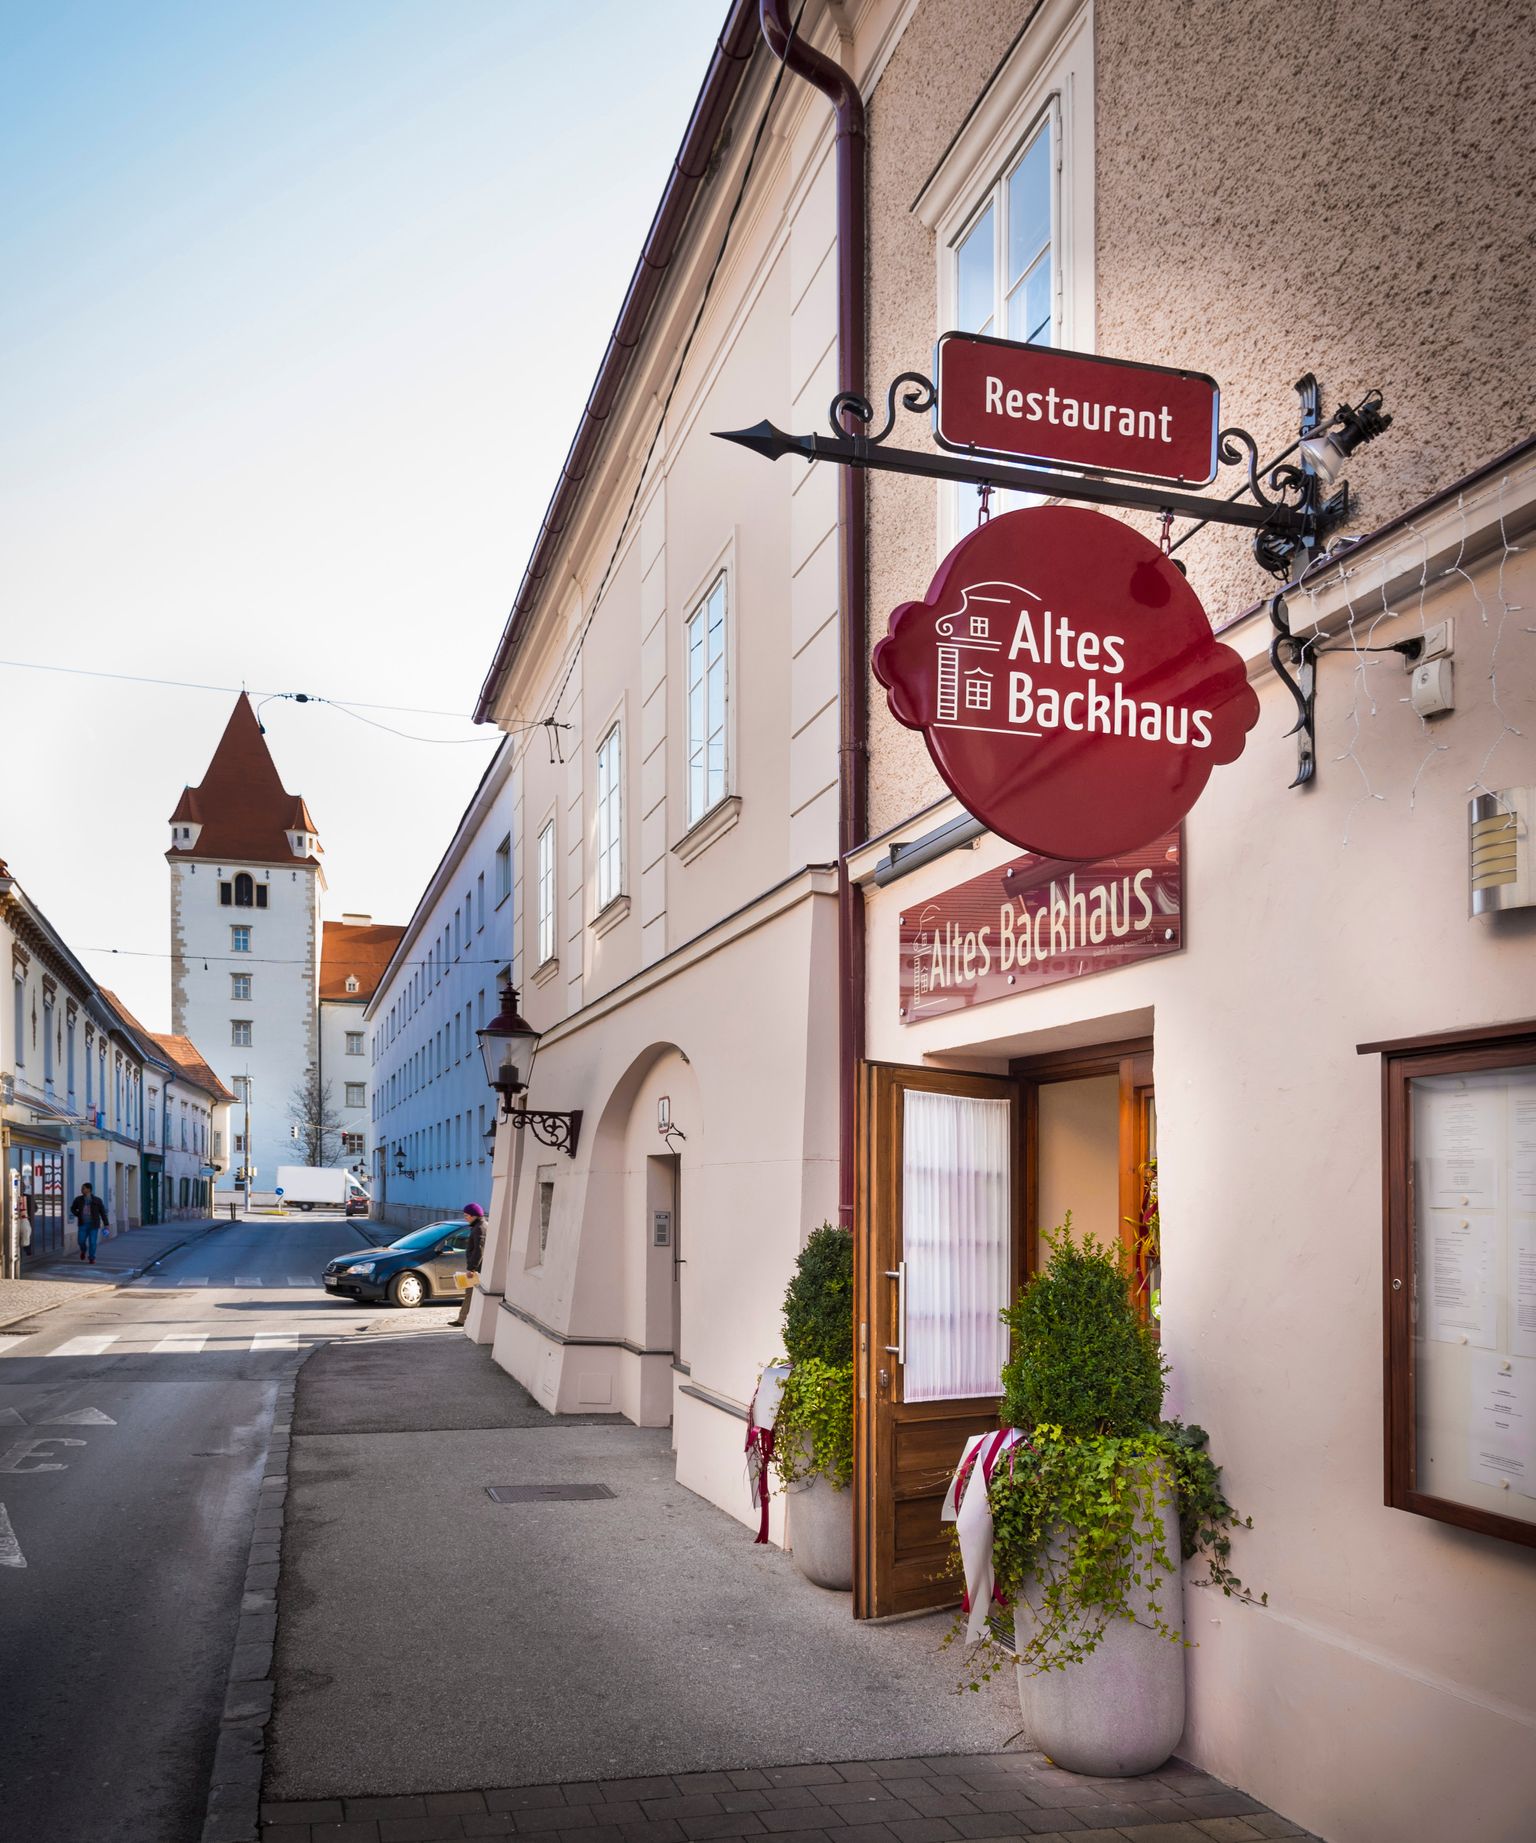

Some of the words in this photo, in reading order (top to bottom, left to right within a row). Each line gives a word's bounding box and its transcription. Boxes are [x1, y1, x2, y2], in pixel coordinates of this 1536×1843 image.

[985, 376, 1173, 442] Restaurant
[1008, 610, 1125, 674] Altes
[1009, 672, 1213, 748] Backhaus
[929, 921, 992, 991] Altes
[1000, 868, 1153, 972] Backhaus
